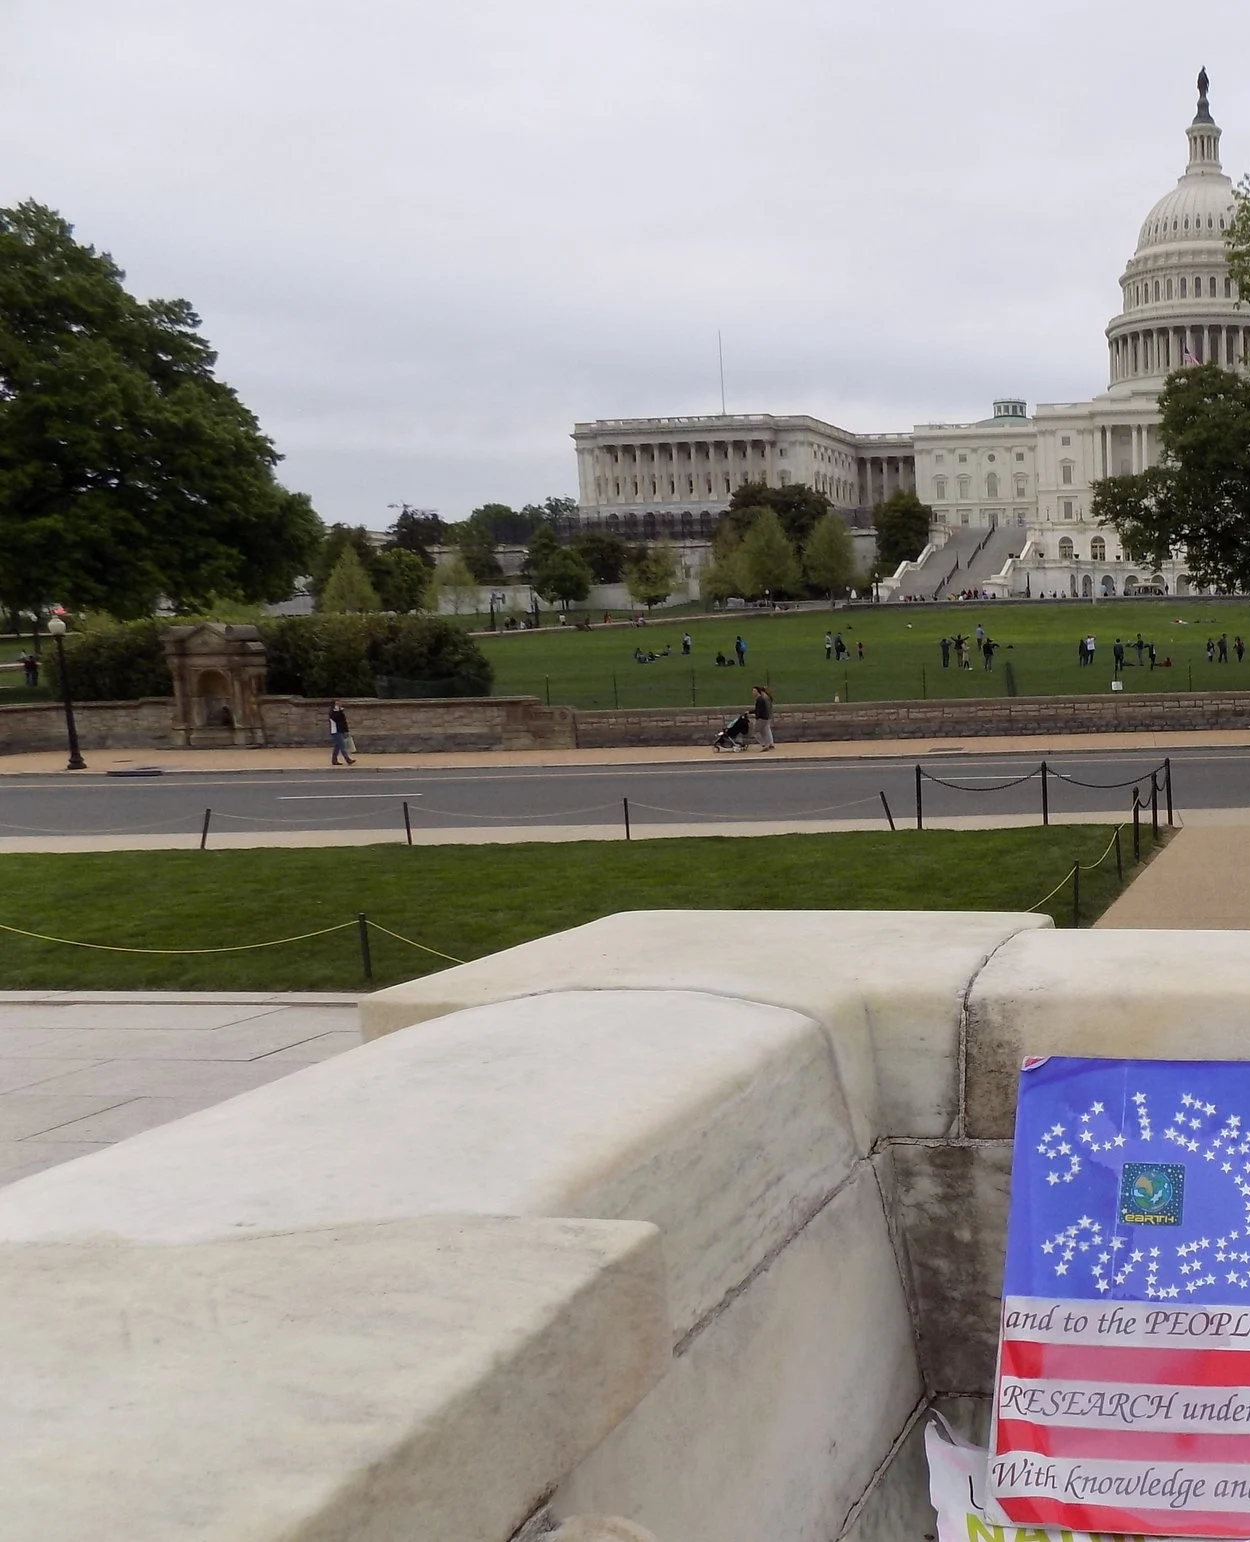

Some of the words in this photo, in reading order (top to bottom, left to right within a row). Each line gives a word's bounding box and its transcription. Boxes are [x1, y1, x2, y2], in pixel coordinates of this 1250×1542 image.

[1005, 1304, 1060, 1332] and
[1064, 1312, 1088, 1333] to
[1098, 1307, 1137, 1335] the
[1001, 1384, 1179, 1424] RESEARCH
[992, 1458, 1058, 1490] With
[1064, 1465, 1206, 1509] knowledge
